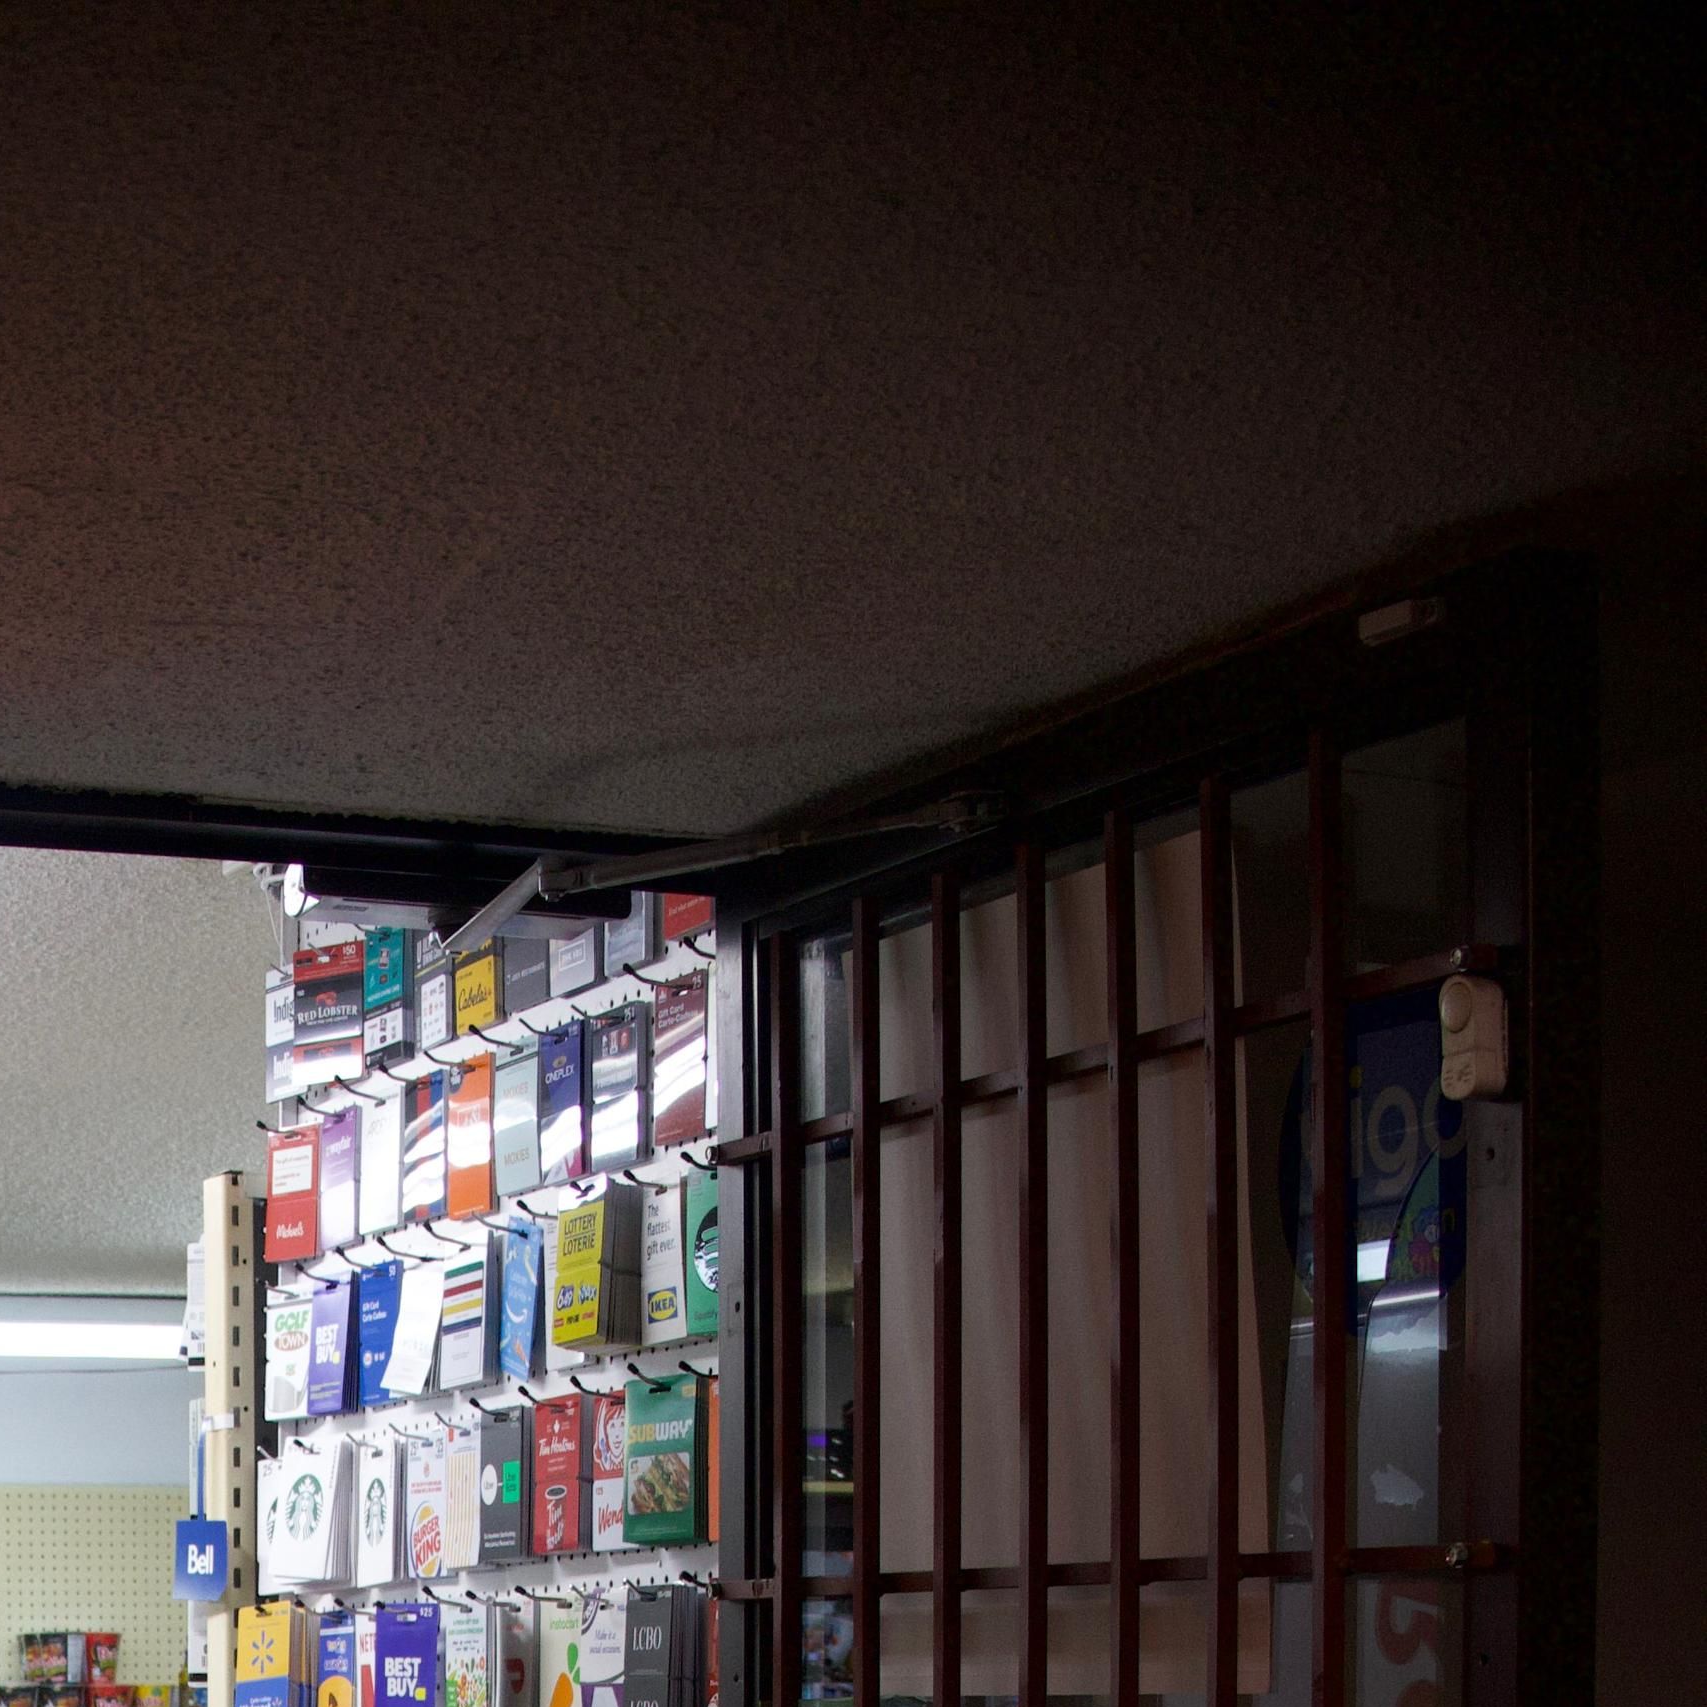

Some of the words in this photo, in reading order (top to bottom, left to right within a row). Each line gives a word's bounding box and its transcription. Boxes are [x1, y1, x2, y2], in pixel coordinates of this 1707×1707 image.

[297, 1011, 317, 1025] RED
[317, 1003, 358, 1019] LOBSTER
[545, 1062, 575, 1085] CINEPLEX
[504, 1147, 530, 1166] MOXIES
[647, 1204, 660, 1219] The
[564, 1212, 597, 1236] LOTTERY
[646, 1219, 671, 1235] flattest
[562, 1233, 596, 1257] LOTERIE
[646, 1242, 659, 1261] gift
[651, 1297, 675, 1313] IKEA
[274, 1310, 309, 1333] GOLF
[275, 1332, 309, 1350] TOWN
[315, 1324, 339, 1344] BEST
[315, 1345, 334, 1364] BUY
[628, 1419, 693, 1444] SUBWAY
[538, 1441, 550, 1457] Tim
[550, 1436, 576, 1453] Hortons
[413, 1516, 440, 1546] BURGER
[187, 1545, 214, 1575] Bell
[414, 1535, 441, 1570] KING
[420, 1606, 433, 1617] $25
[632, 1626, 662, 1651] LCBO
[384, 1657, 422, 1677] BEST
[387, 1677, 417, 1698] BUY
